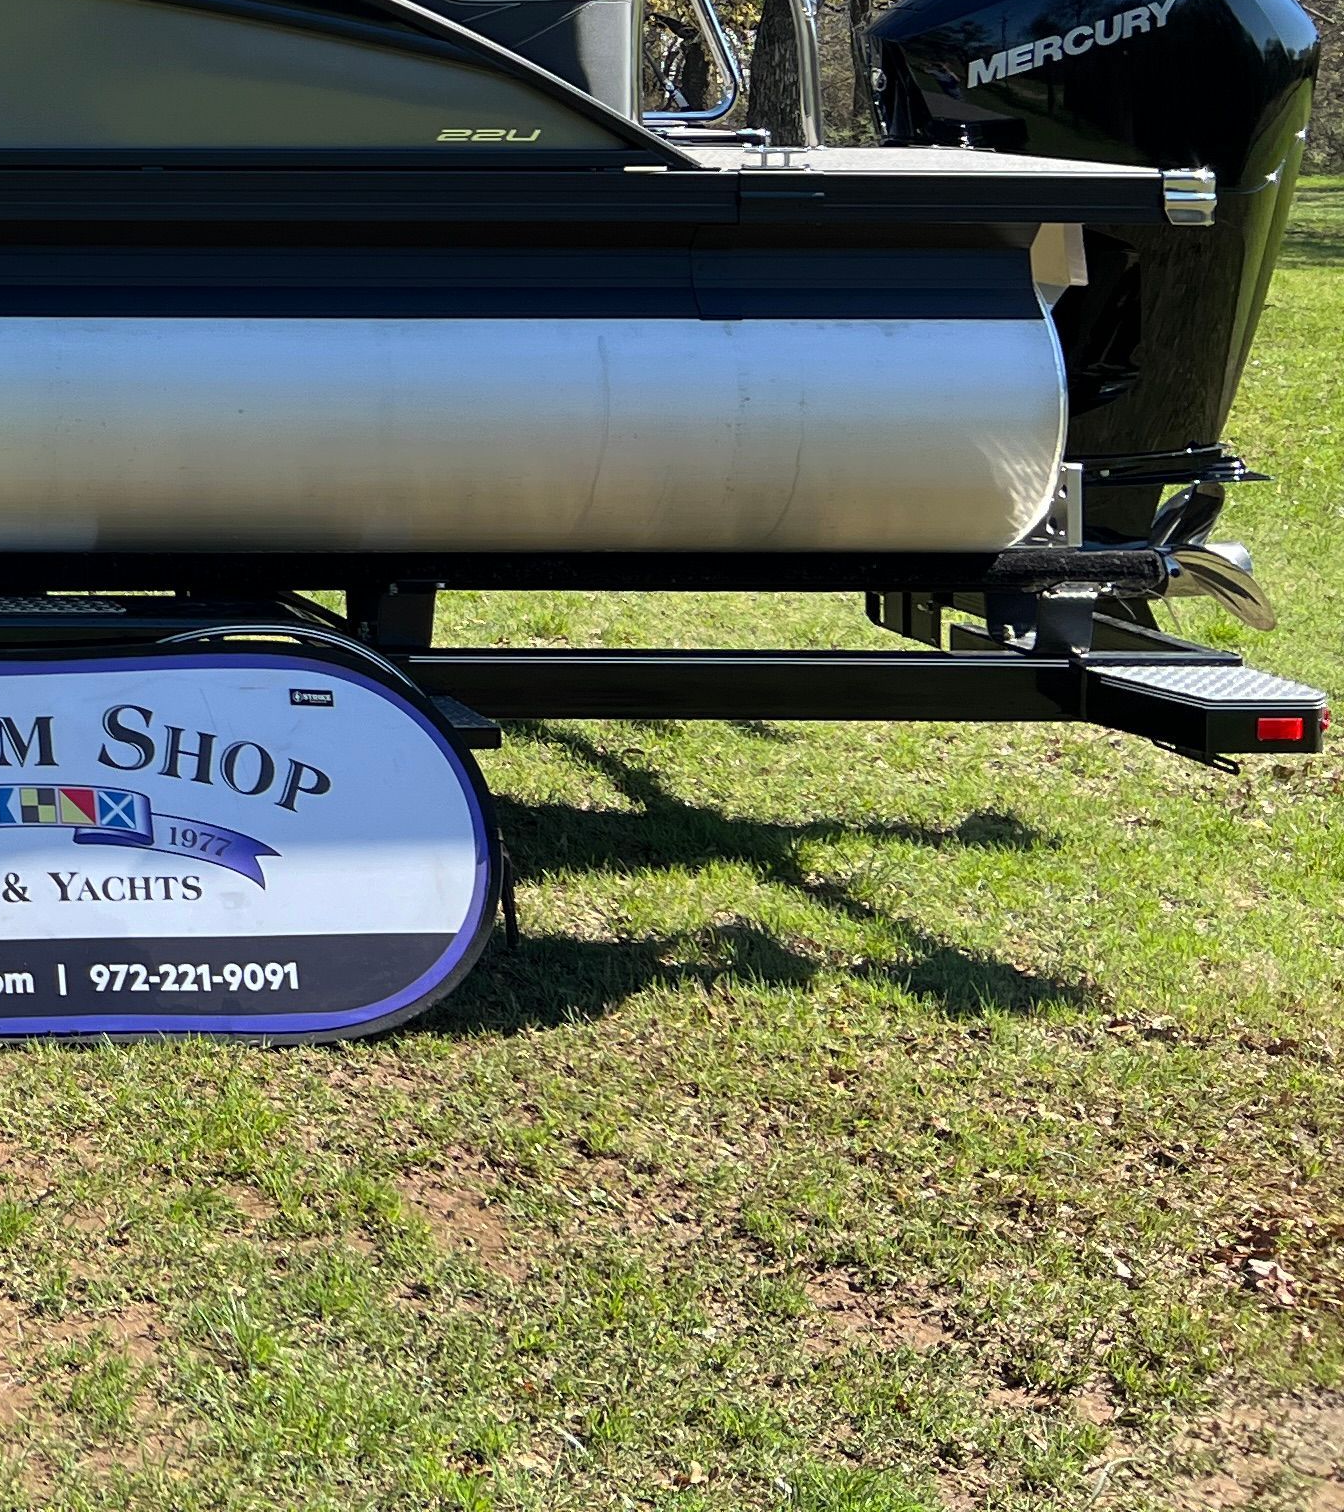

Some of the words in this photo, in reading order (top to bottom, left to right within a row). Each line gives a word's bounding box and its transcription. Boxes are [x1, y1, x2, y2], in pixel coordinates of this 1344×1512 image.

[436, 128, 542, 142] 22U
[97, 703, 332, 813] SHOP
[169, 826, 232, 857] 1977
[1, 871, 32, 903] &
[46, 871, 203, 902] YACHTS
[89, 961, 299, 992] 972-221-9091
